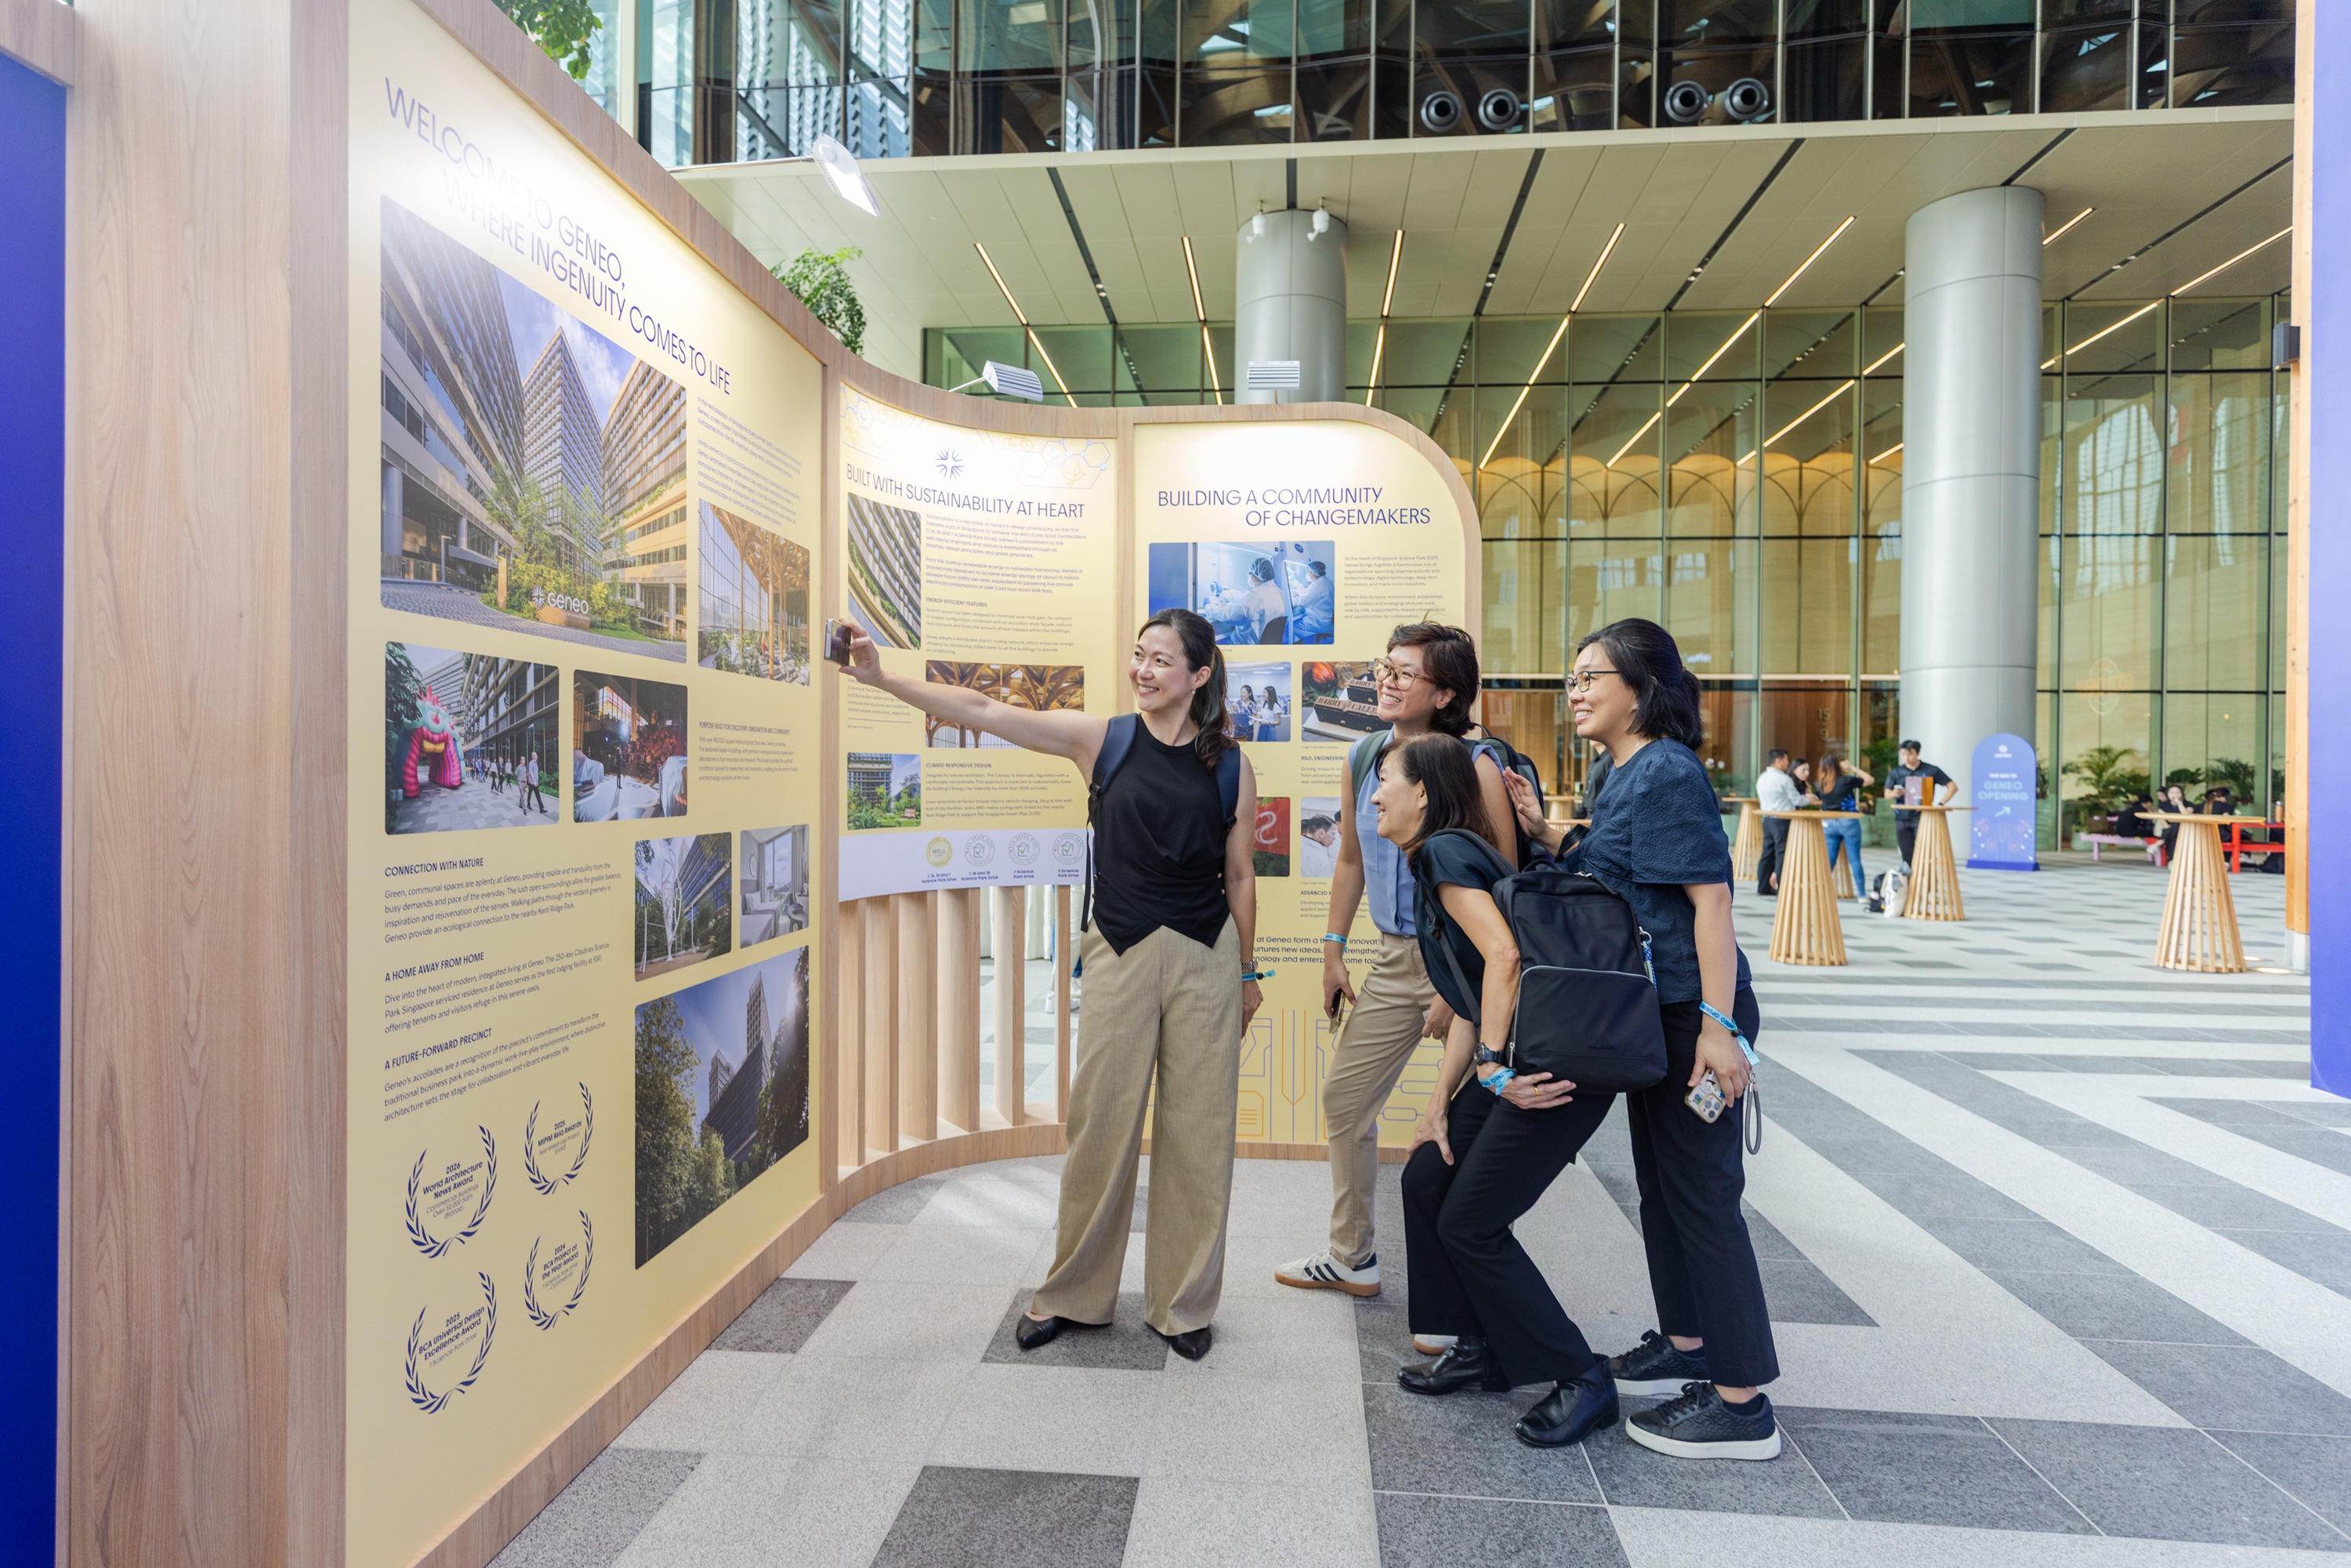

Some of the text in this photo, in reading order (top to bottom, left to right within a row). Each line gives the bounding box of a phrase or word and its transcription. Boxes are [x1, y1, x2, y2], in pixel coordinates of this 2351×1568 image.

[384, 76, 625, 291] WELCOME TO GENEO,
[442, 168, 730, 396] WHERE INGENUITY COMES TO LIFE
[847, 463, 1085, 518] BUILT WITH SUSTAINABILITY AT HEART
[1158, 487, 1383, 507] BUILDING A COMMUNITY
[1245, 508, 1430, 527] OF CHANGEMAKERS
[926, 597, 965, 606] ENERGY-EFFICIENT
[1349, 679, 1371, 687] BARRY
[1317, 697, 1344, 707] BARRY
[1978, 791, 2029, 801] OPENING
[1983, 780, 2023, 791] GENEO
[385, 857, 484, 877] CONNECTION WITH NATURE
[385, 890, 407, 899] Green,
[408, 884, 443, 896] communal
[444, 882, 464, 892] spaces
[475, 878, 496, 888] aplenty
[503, 875, 522, 883] Geneo,
[522, 871, 545, 882] providing
[545, 869, 561, 878] respite
[561, 867, 571, 875] and
[571, 865, 593, 874] tranquility
[385, 933, 408, 943] Geneo
[408, 927, 433, 940] provide
[443, 920, 472, 932] ecological
[473, 915, 503, 927] connection
[520, 909, 538, 918] nearby
[550, 905, 563, 914] Ridge
[385, 951, 484, 983] A HOME AWAY FROM HOME
[385, 994, 400, 1005] Dive
[402, 991, 415, 1000] into
[416, 988, 427, 997] the
[428, 983, 445, 993] heart
[446, 980, 453, 989] of
[454, 976, 478, 987] modern,
[479, 967, 506, 980] integrated
[507, 965, 521, 973] living
[528, 959, 545, 969] Geneo.
[555, 952, 574, 961] 250-key
[574, 947, 594, 957] Citadines
[594, 943, 610, 951] Science
[385, 1020, 411, 1034] offering
[412, 1013, 437, 1026] tenants
[438, 1008, 450, 1019] and
[451, 1004, 473, 1015] visitors
[473, 998, 491, 1009] refuge
[498, 993, 509, 1001] this
[509, 989, 526, 998] serene
[527, 984, 540, 994] oasis.
[385, 1028, 491, 1070] A FUTURE-FORWARD PRECINCT
[538, 1121, 582, 1147] MIPIM Asia Awards
[554, 1120, 566, 1131] 2025
[423, 1161, 483, 1195] World Architecture
[446, 1162, 461, 1175] 2026
[434, 1175, 473, 1200] News Award
[543, 1244, 578, 1271] BCA Project of
[555, 1243, 566, 1255] 2024
[542, 1251, 578, 1280] the Year Award
[418, 1307, 485, 1355] BCA Universal Design
[446, 1313, 461, 1327] 2025
[425, 1317, 481, 1361] Excellence Award
